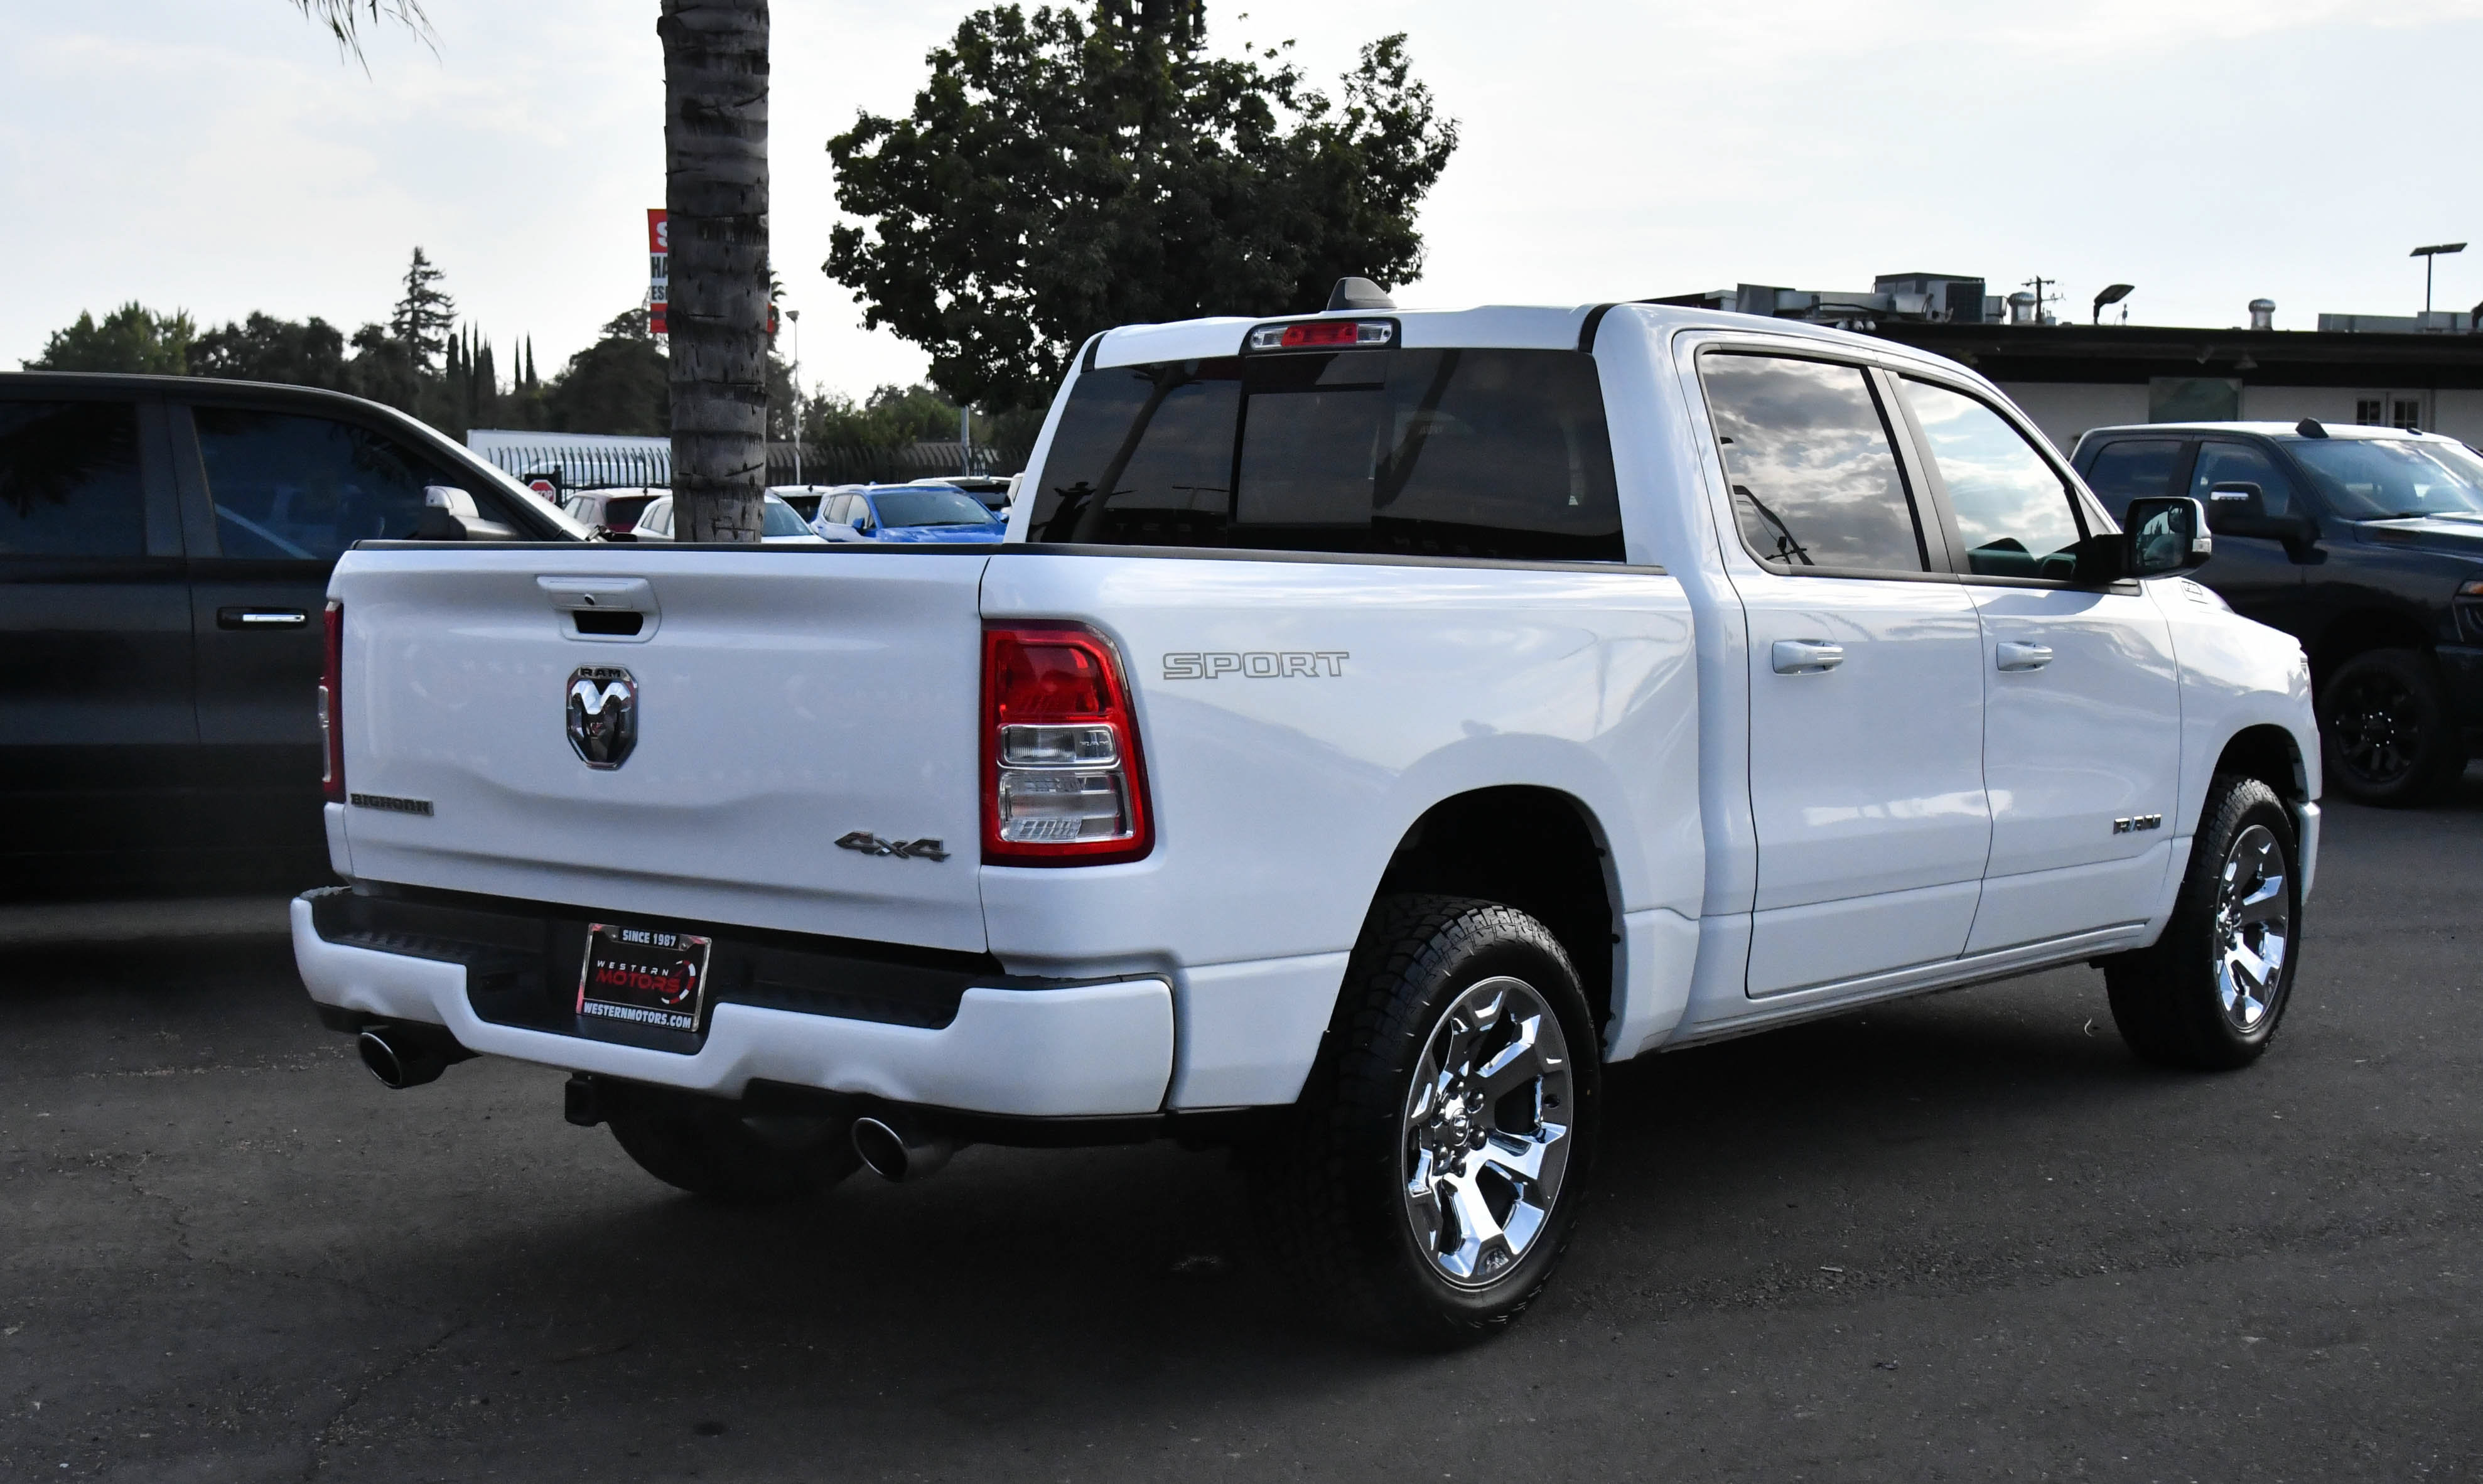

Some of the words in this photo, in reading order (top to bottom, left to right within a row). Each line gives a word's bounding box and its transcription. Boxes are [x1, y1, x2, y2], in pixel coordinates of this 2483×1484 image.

[580, 668, 621, 678] RAM
[1163, 652, 1350, 680] SPORT
[2113, 814, 2162, 835] RAM
[623, 929, 650, 944] SINCE
[653, 933, 677, 947] 1987
[597, 960, 669, 976] WESTERN
[596, 969, 681, 994] MOTORS
[584, 1002, 692, 1029] WESTERNMOTORS.COM
